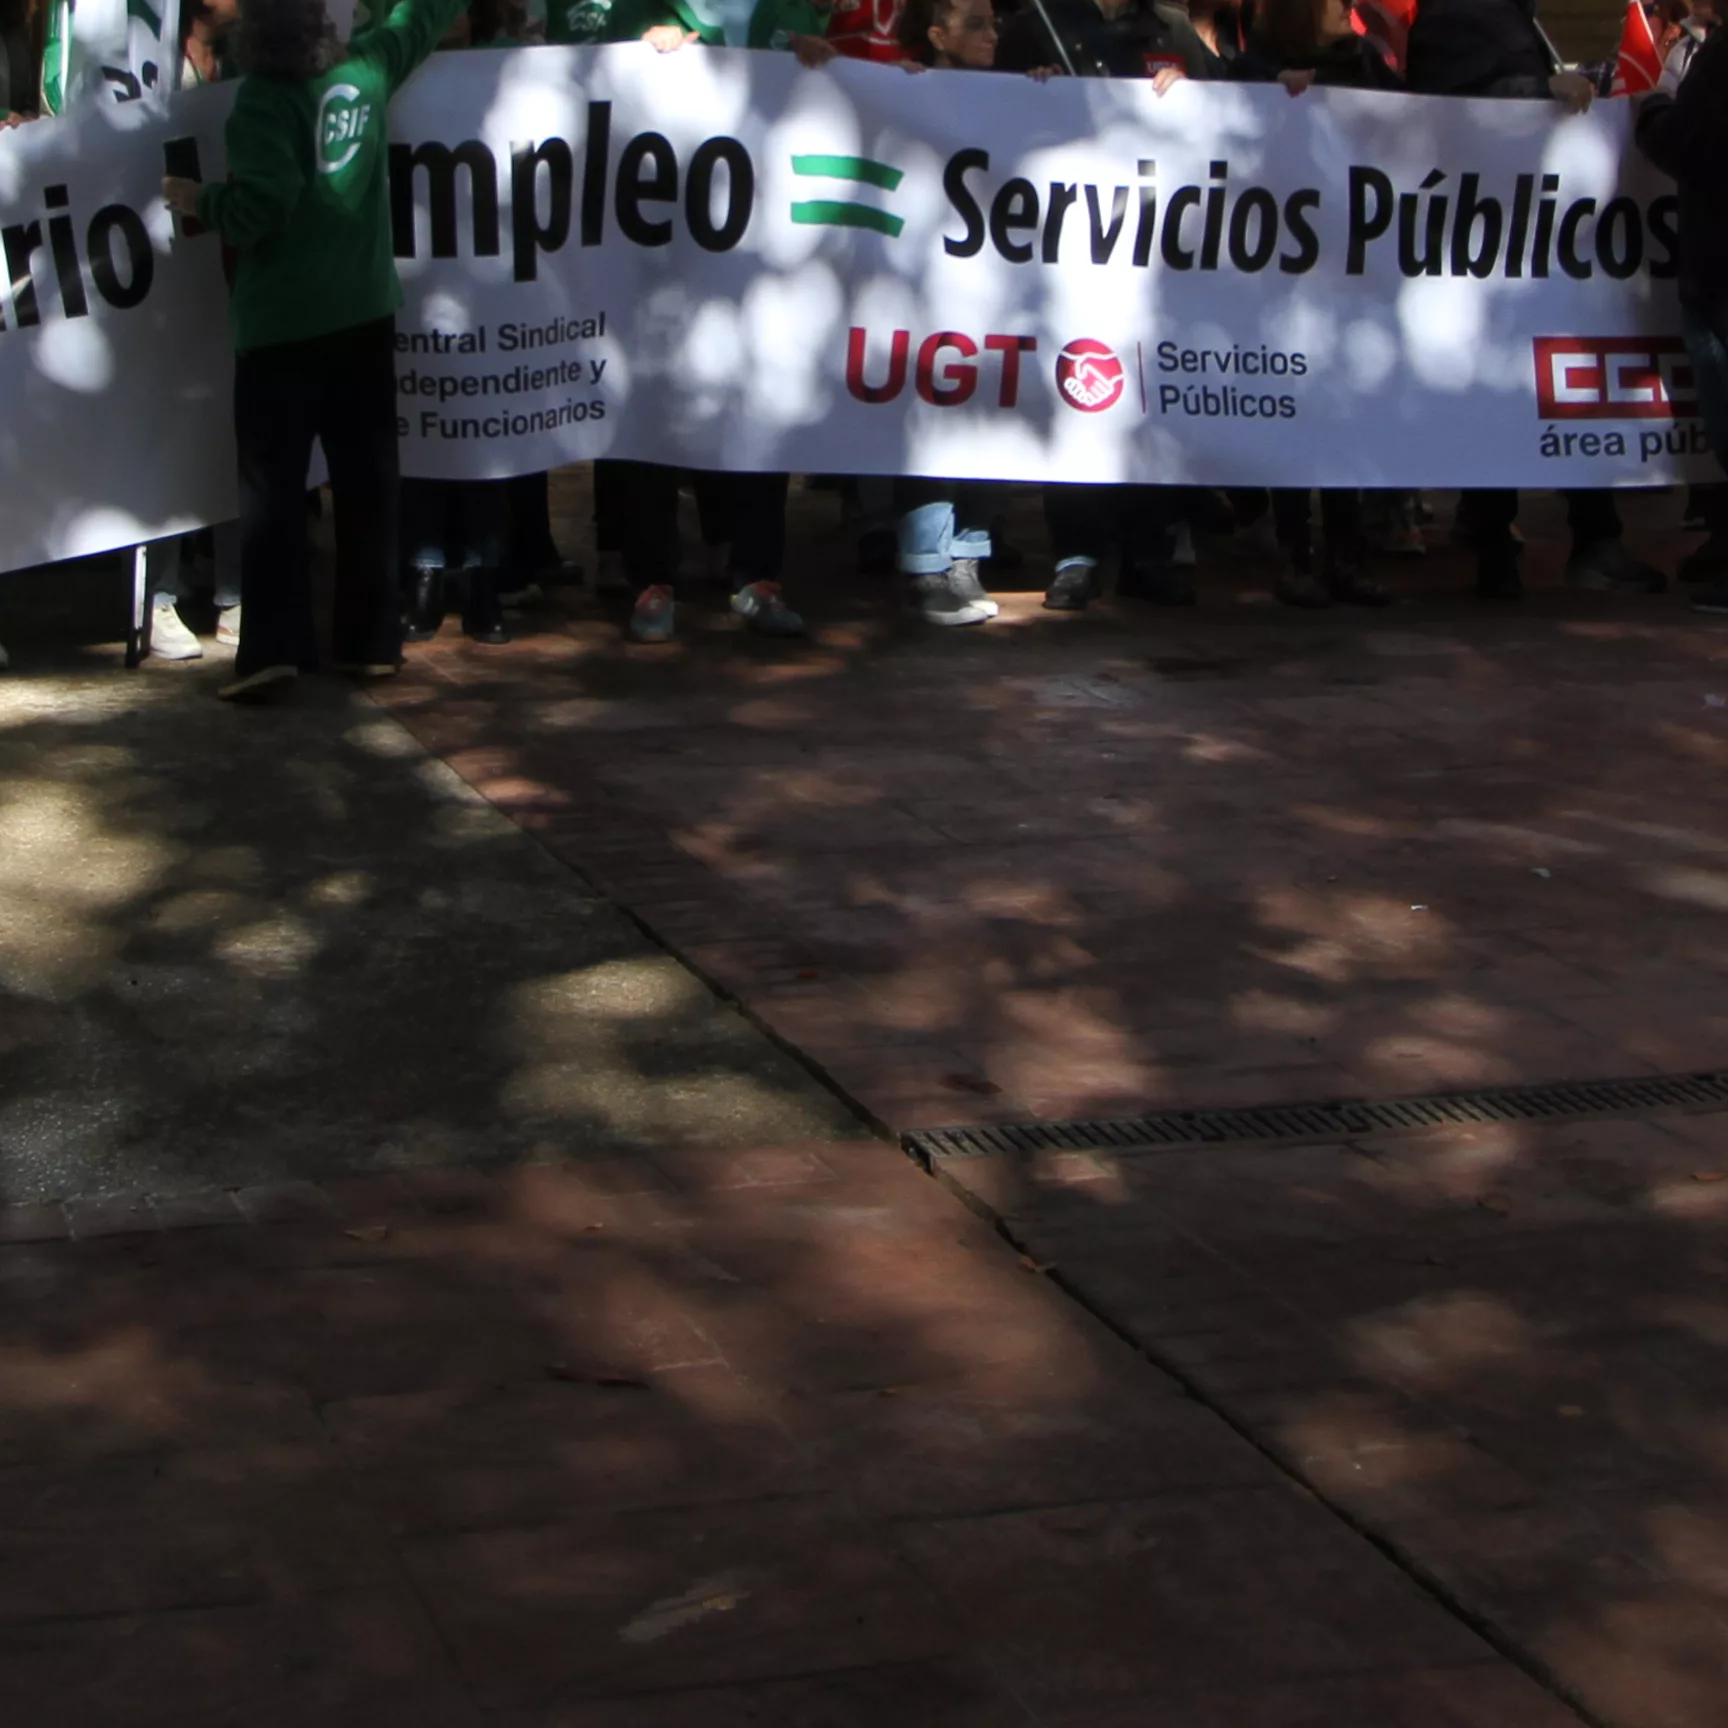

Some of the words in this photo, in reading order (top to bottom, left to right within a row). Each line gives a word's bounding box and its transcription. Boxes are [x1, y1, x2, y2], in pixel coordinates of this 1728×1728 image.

[324, 104, 371, 145] CSIF
[388, 100, 755, 282] mpleo
[942, 147, 1321, 273] Servicios
[1345, 164, 1678, 280] Públicos
[393, 324, 487, 355] entral
[497, 311, 606, 353] Sindical
[394, 356, 581, 401] dependiente
[589, 357, 607, 385] y
[845, 326, 1037, 408] UGT
[1156, 341, 1308, 375] Servicios
[419, 397, 606, 440] Funcionarios
[1159, 385, 1296, 419] Públicos
[1539, 425, 1626, 458] área
